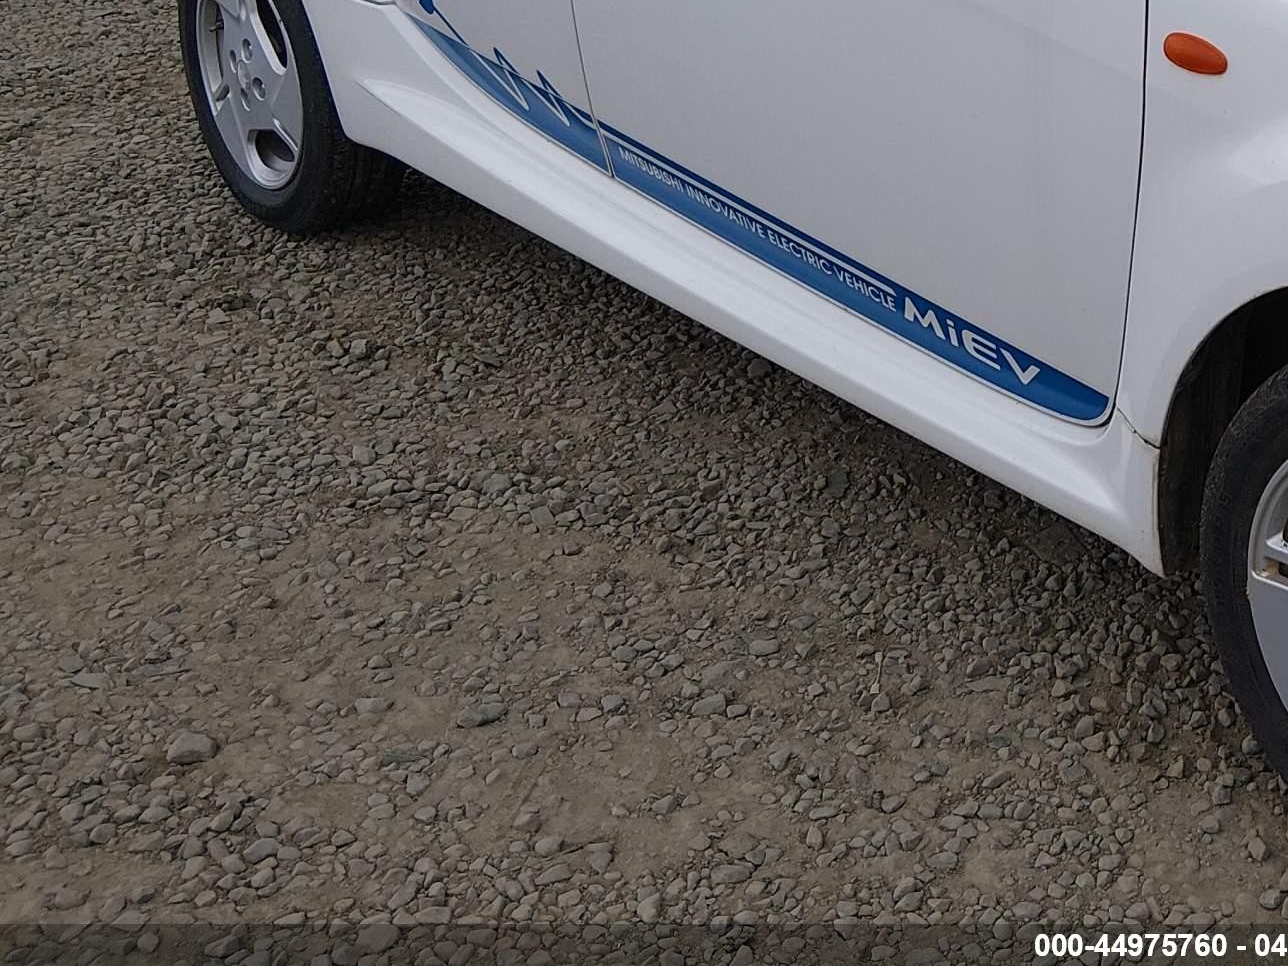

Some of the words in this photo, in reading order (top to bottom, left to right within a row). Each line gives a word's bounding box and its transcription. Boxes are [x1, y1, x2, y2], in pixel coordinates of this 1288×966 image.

[618, 145, 684, 193] MITSUBISHI
[686, 183, 766, 239] INNOVATIVE
[768, 229, 833, 276] ELECTRIC
[834, 265, 897, 312] VEHICLE
[903, 296, 1041, 386] MiEV
